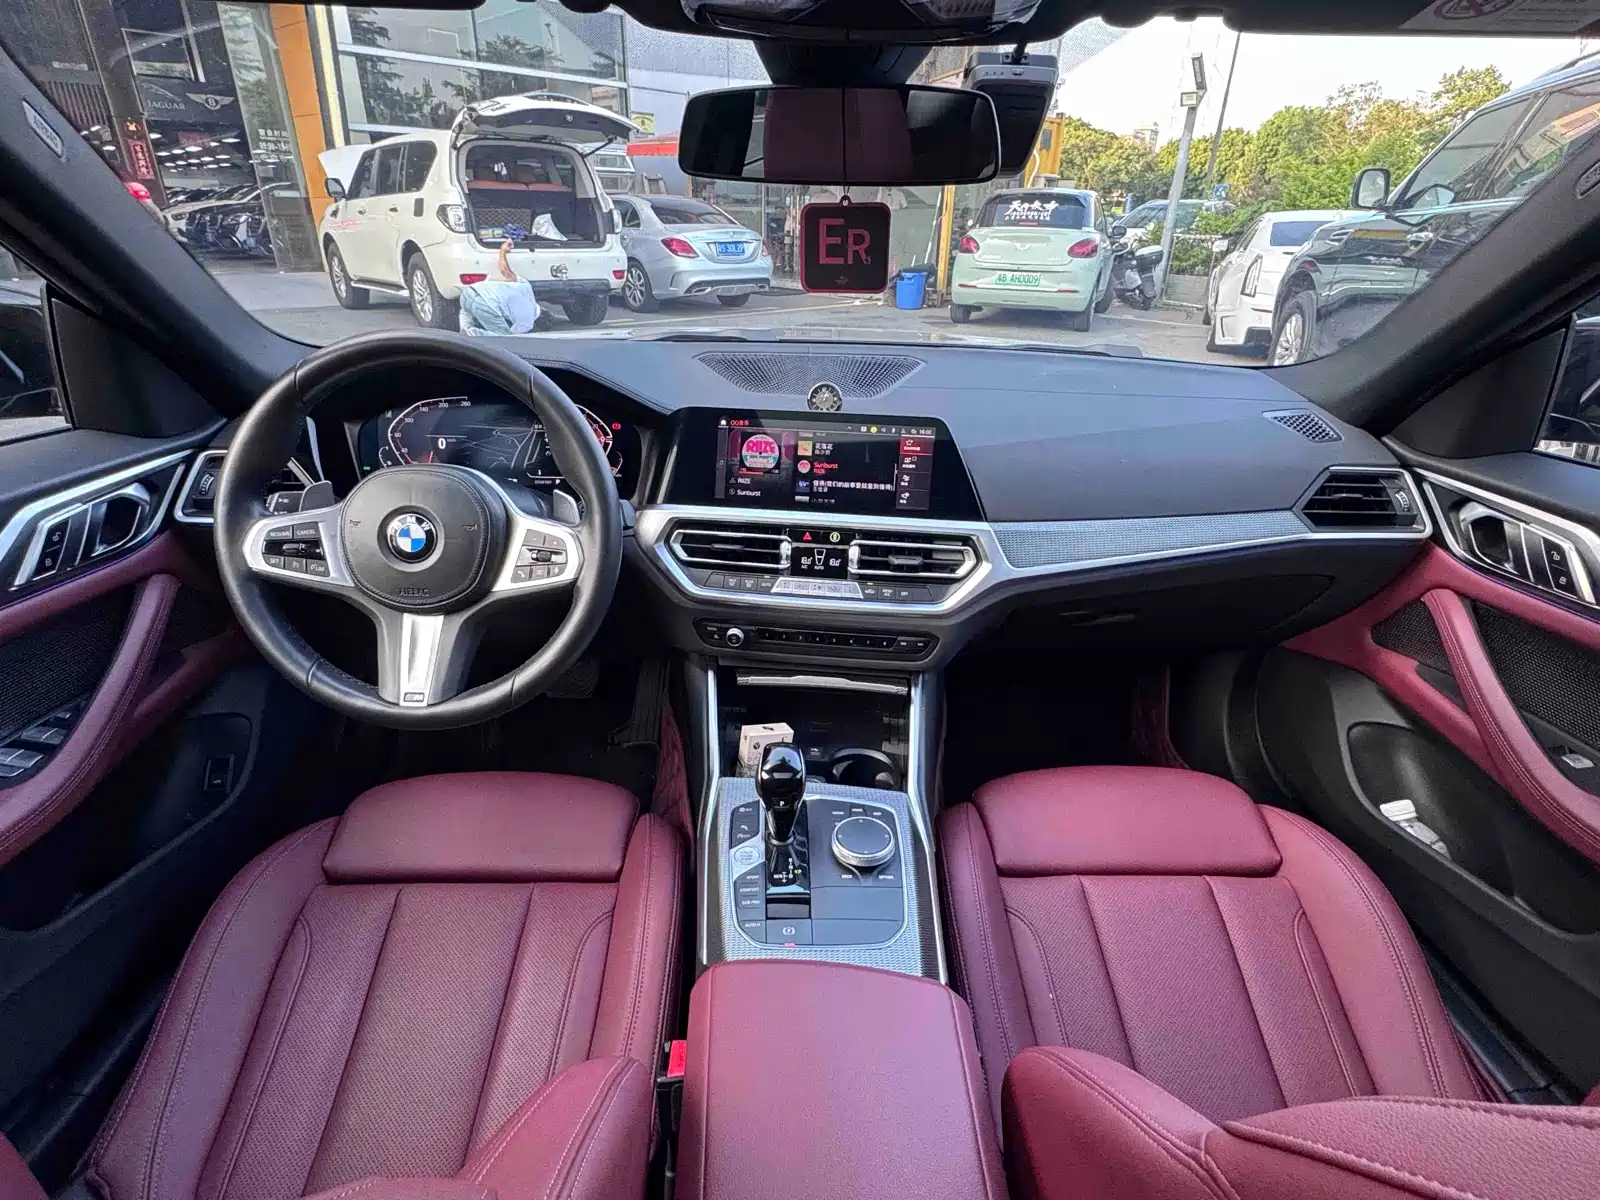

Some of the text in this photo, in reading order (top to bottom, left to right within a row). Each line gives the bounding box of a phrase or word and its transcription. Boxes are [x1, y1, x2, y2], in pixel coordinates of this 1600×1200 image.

[147, 100, 187, 110] JAGUAR
[438, 438, 446, 449] 0
[813, 461, 838, 469] Sunburst
[736, 489, 761, 497] Sunburst
[392, 516, 432, 531] BMW
[400, 588, 430, 597] AIRBAG
